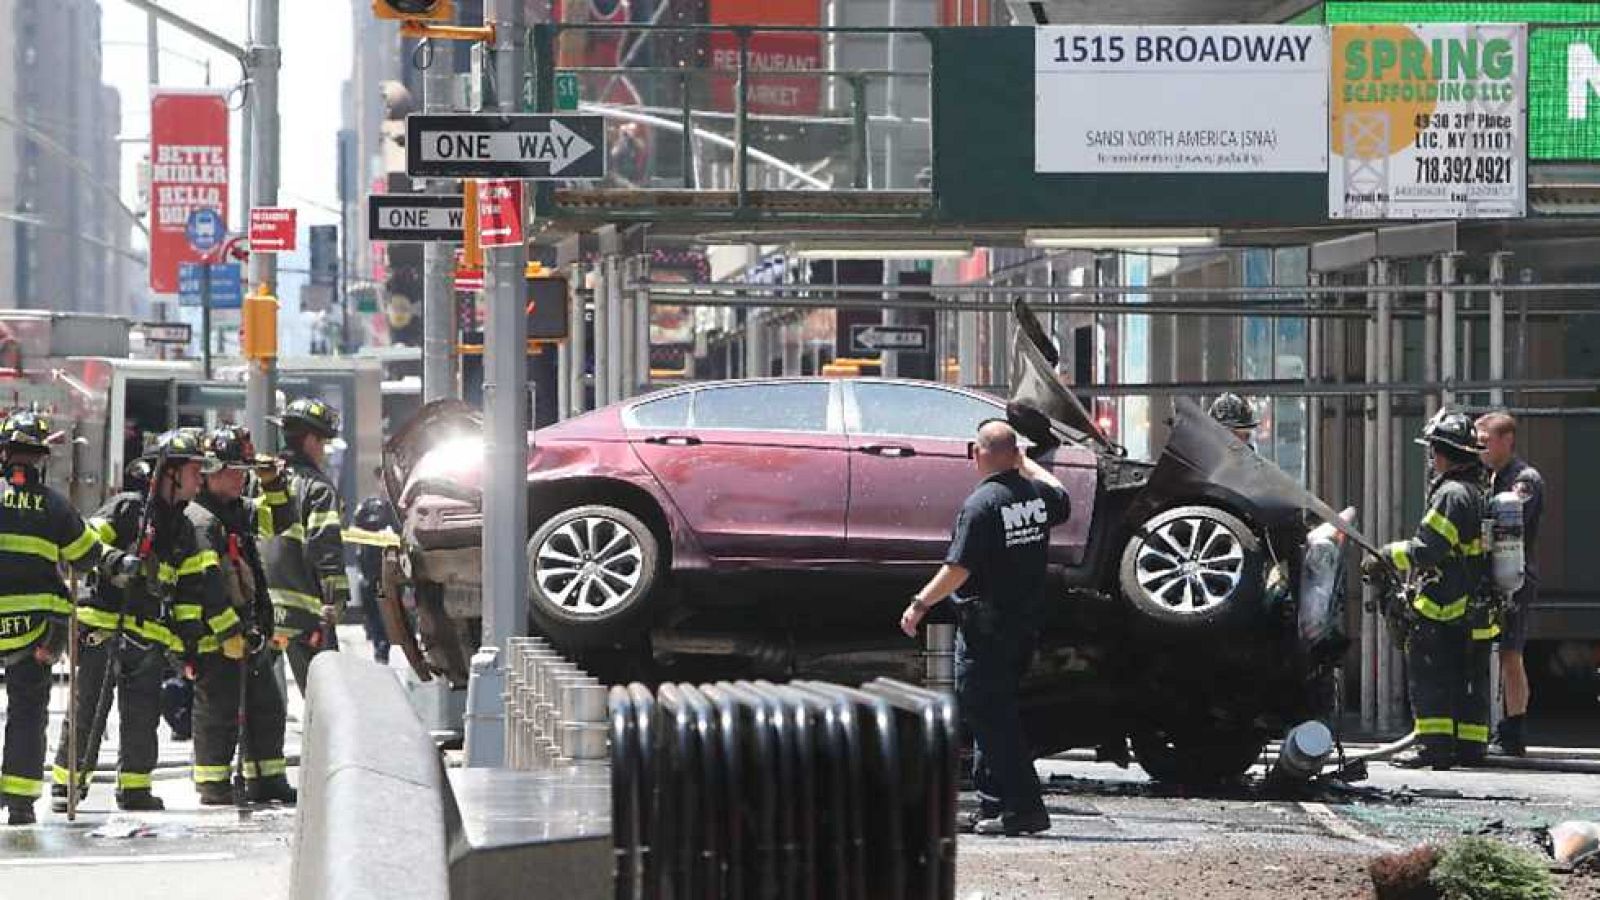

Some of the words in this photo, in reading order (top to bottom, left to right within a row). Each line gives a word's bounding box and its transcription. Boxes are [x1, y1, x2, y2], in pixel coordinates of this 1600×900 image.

[1053, 36, 1124, 62] 1515
[1135, 35, 1312, 62] BROADWAY
[1344, 38, 1514, 80] SPRING
[732, 85, 799, 106] ARKET
[1478, 113, 1511, 128] Place
[436, 135, 491, 158] ONE
[518, 135, 574, 159] WAY
[1085, 130, 1124, 147] SANSI
[1128, 130, 1174, 147] NORTH
[1177, 130, 1237, 147] AMERICA
[158, 145, 223, 164] BETTE
[1415, 156, 1511, 184] 718.392.4921
[389, 208, 430, 228] ONE
[1001, 498, 1048, 530] NYC
